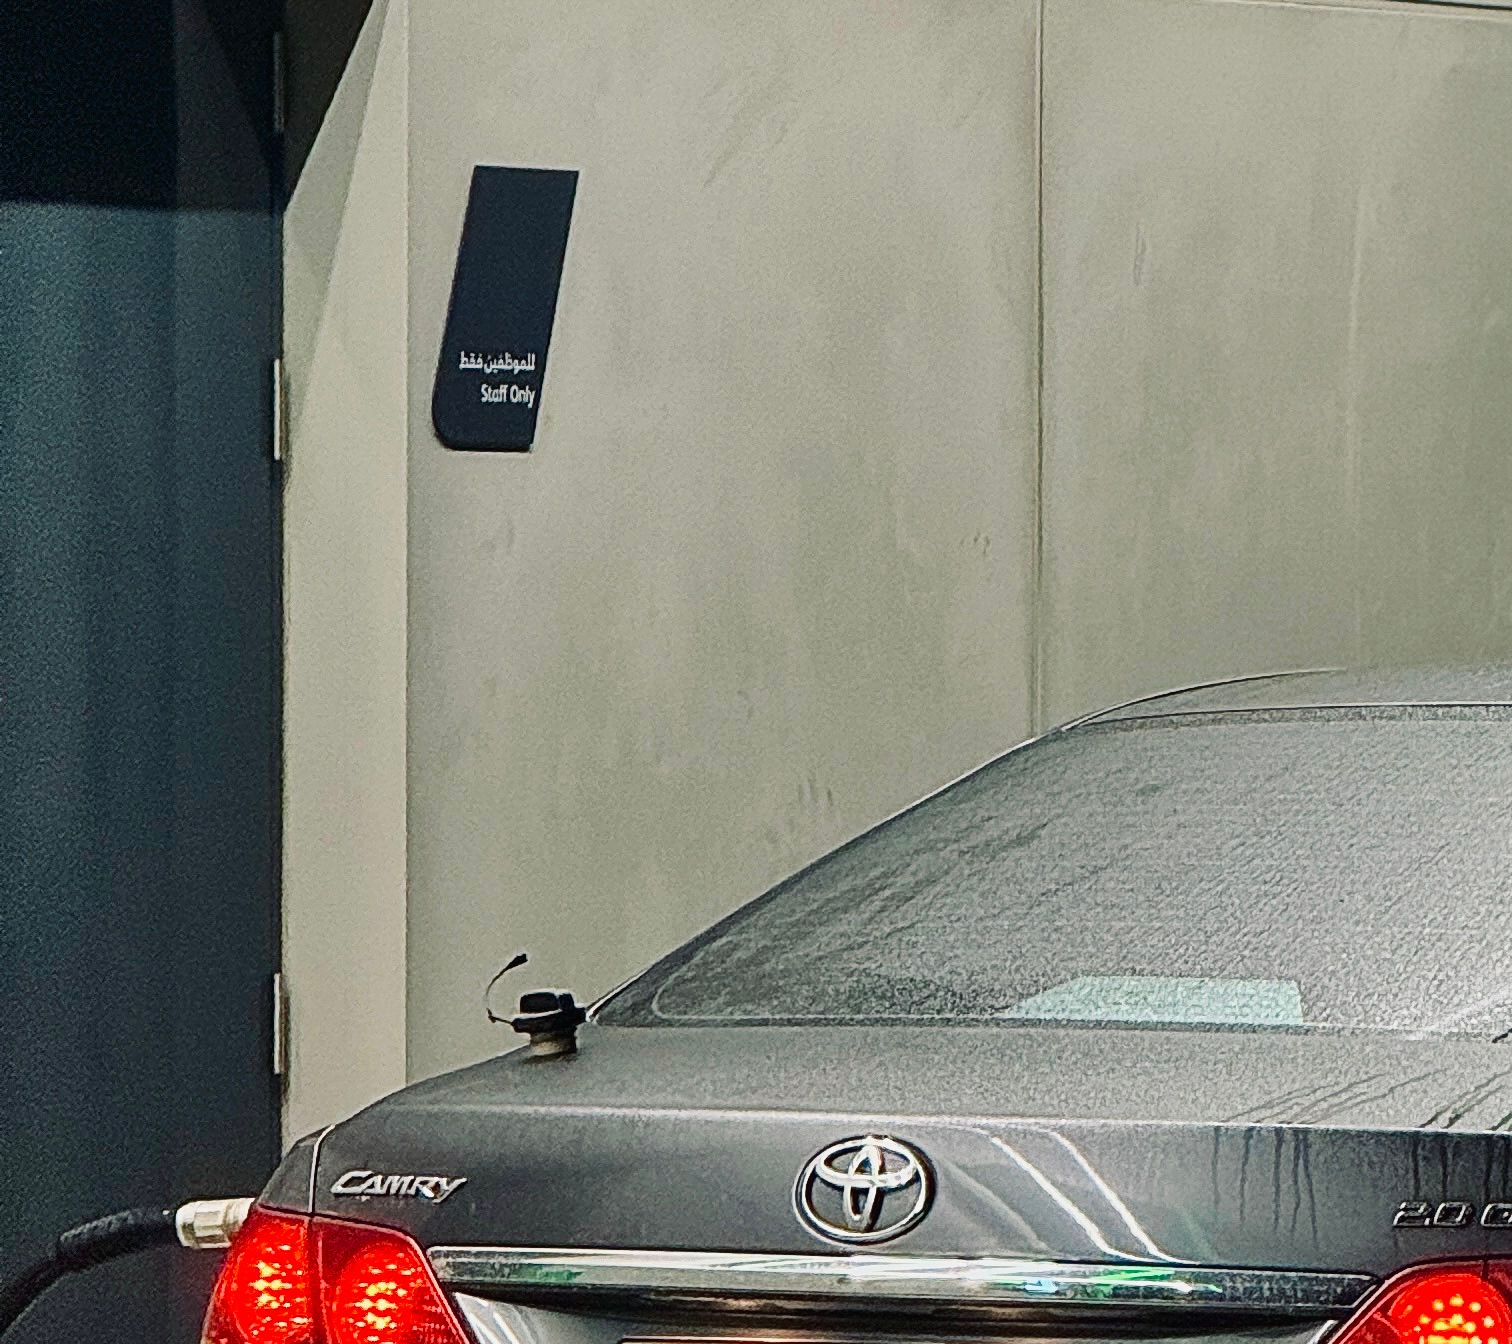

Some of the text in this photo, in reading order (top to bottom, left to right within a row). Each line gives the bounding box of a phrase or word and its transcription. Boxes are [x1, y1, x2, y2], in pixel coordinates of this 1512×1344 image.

[459, 350, 536, 375] للموظفين فقط
[480, 383, 536, 409] Staff Only
